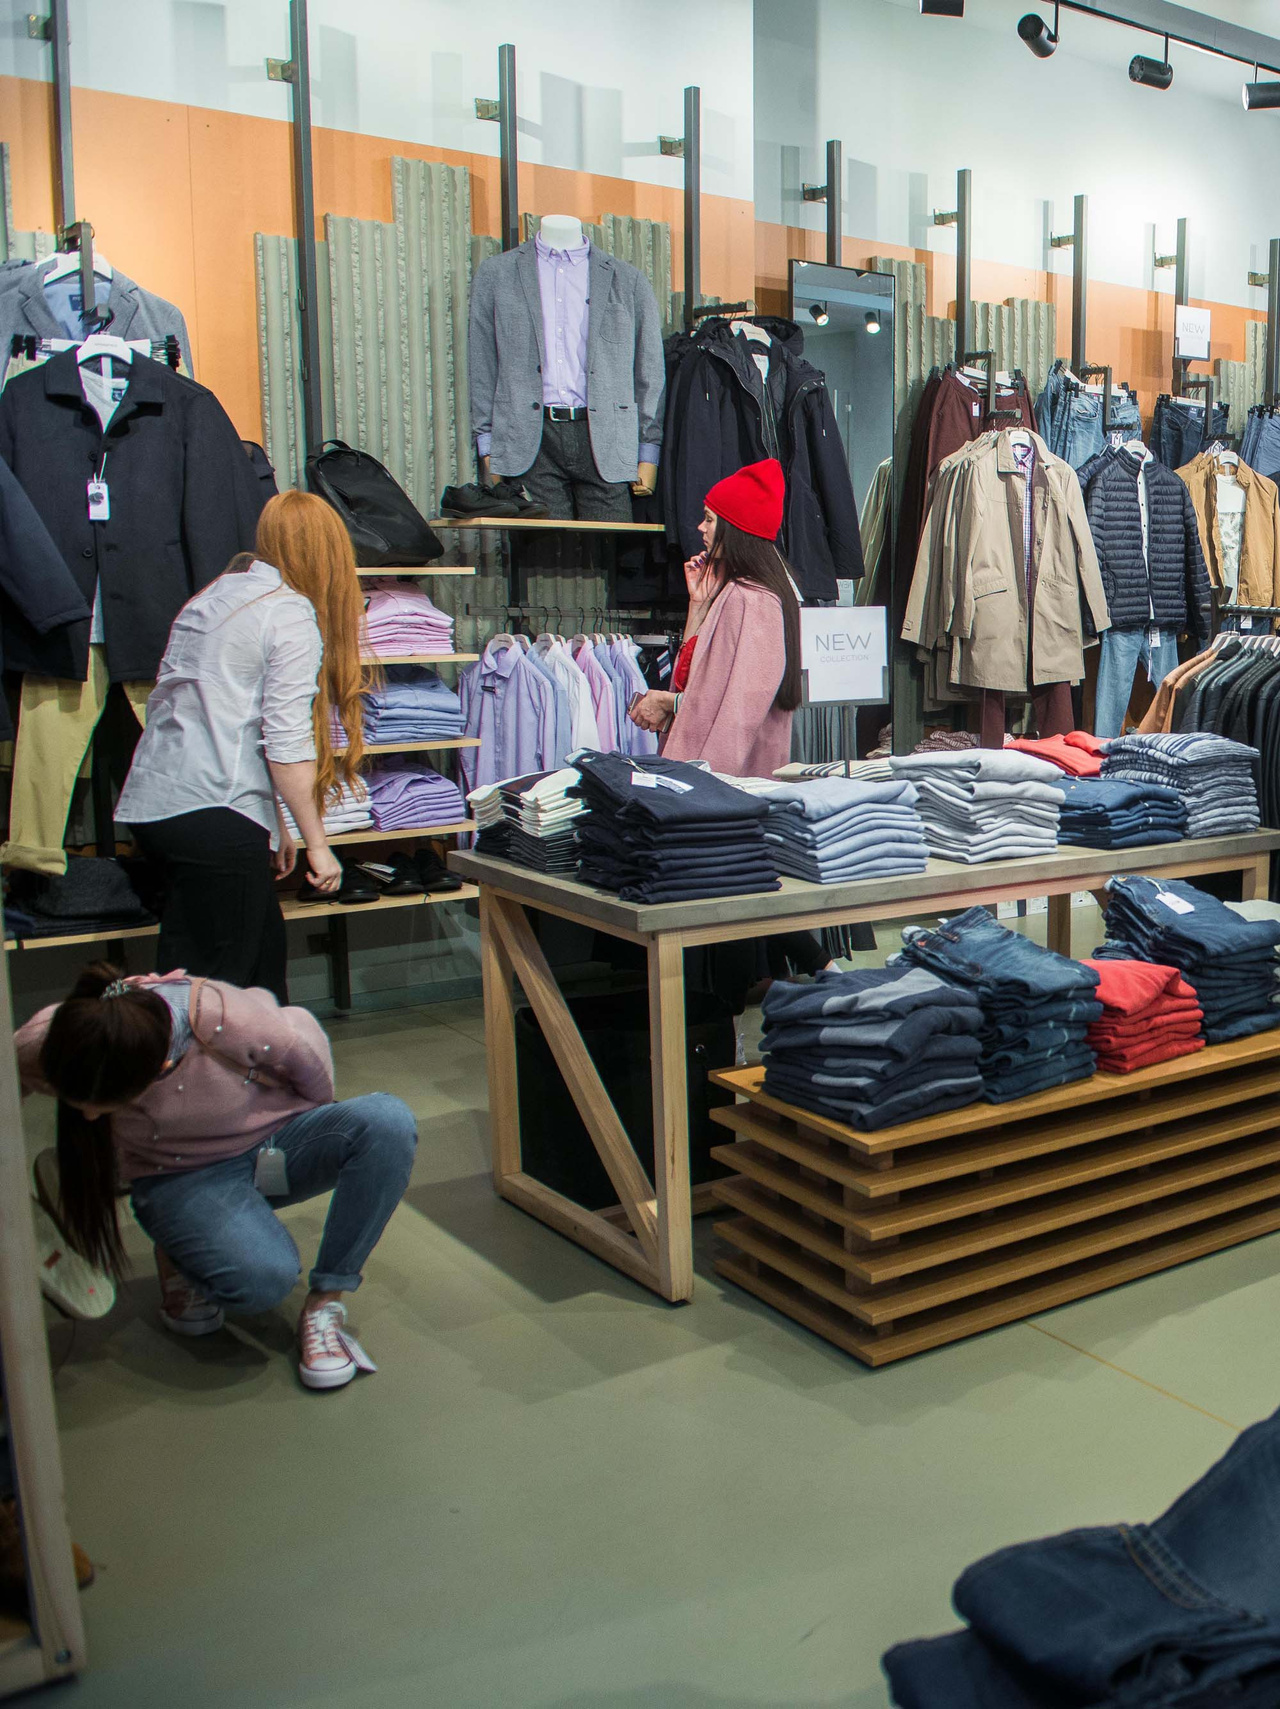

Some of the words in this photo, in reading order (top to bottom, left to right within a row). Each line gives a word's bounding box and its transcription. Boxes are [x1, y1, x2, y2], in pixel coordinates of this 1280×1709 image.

[1182, 322, 1206, 334] NEW
[815, 631, 872, 652] NEW
[820, 654, 869, 663] COLLECTION
